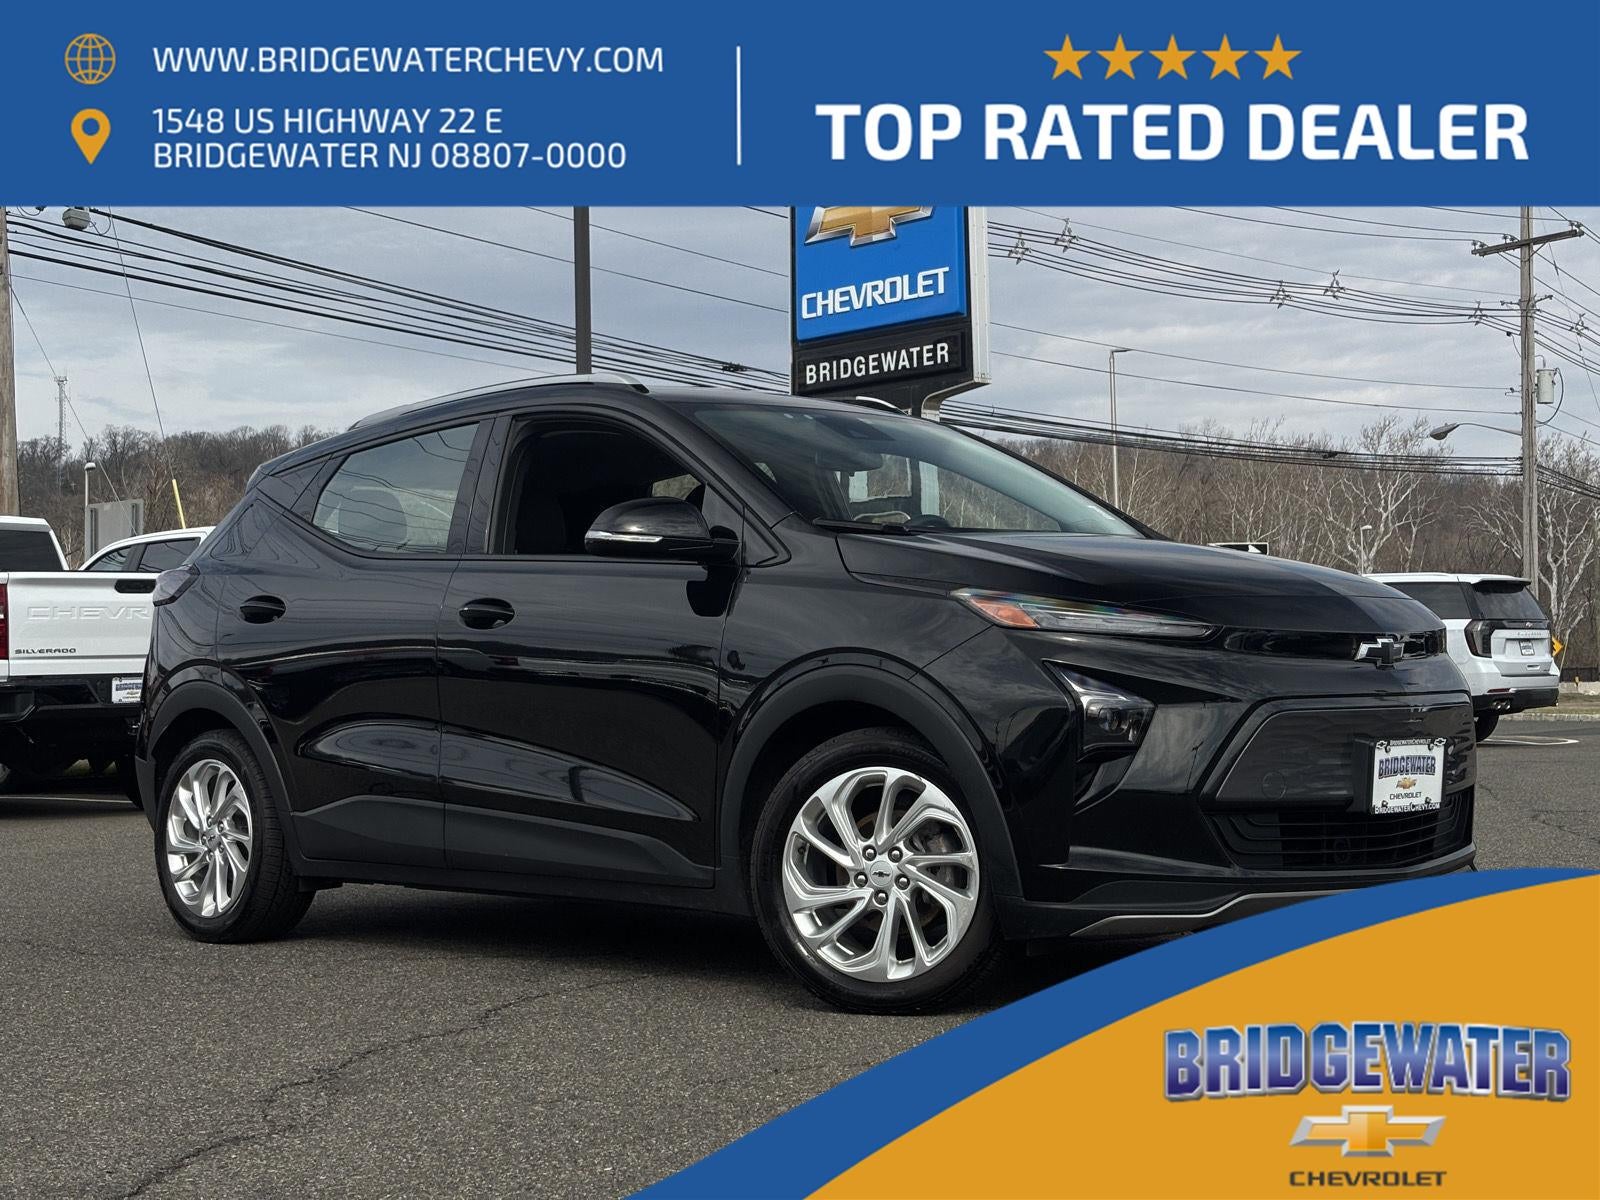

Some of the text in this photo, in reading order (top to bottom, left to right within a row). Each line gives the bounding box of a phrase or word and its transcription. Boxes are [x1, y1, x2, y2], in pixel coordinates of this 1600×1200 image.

[801, 266, 950, 320] CHEVROLET
[805, 342, 950, 385] BRIDGEWATER
[14, 647, 77, 655] SILVERADO
[1378, 755, 1436, 780] BRIDGEWATER
[1389, 791, 1422, 800] CHEVROLET
